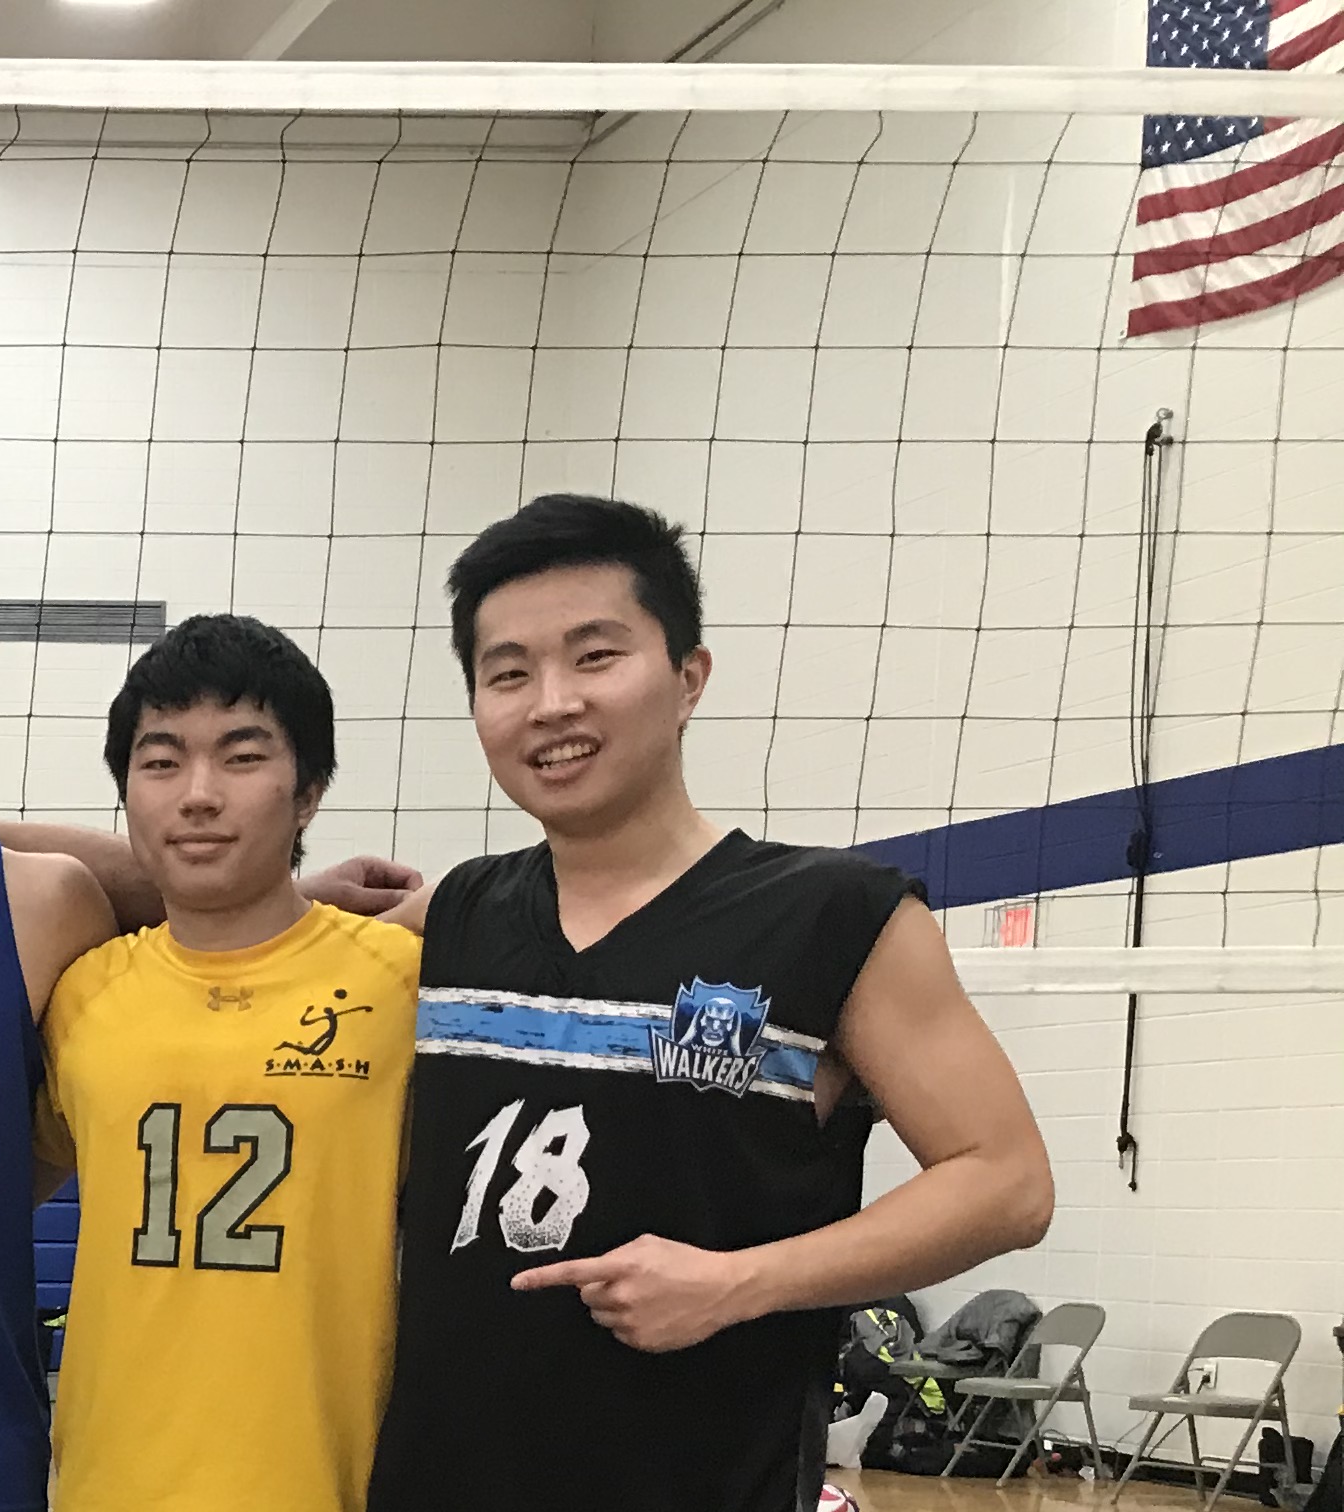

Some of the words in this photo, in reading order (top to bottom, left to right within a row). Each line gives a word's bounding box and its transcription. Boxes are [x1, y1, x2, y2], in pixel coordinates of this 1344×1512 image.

[657, 1037, 757, 1091] WALKERS
[131, 1102, 294, 1273] 12
[450, 1097, 591, 1254] 18
